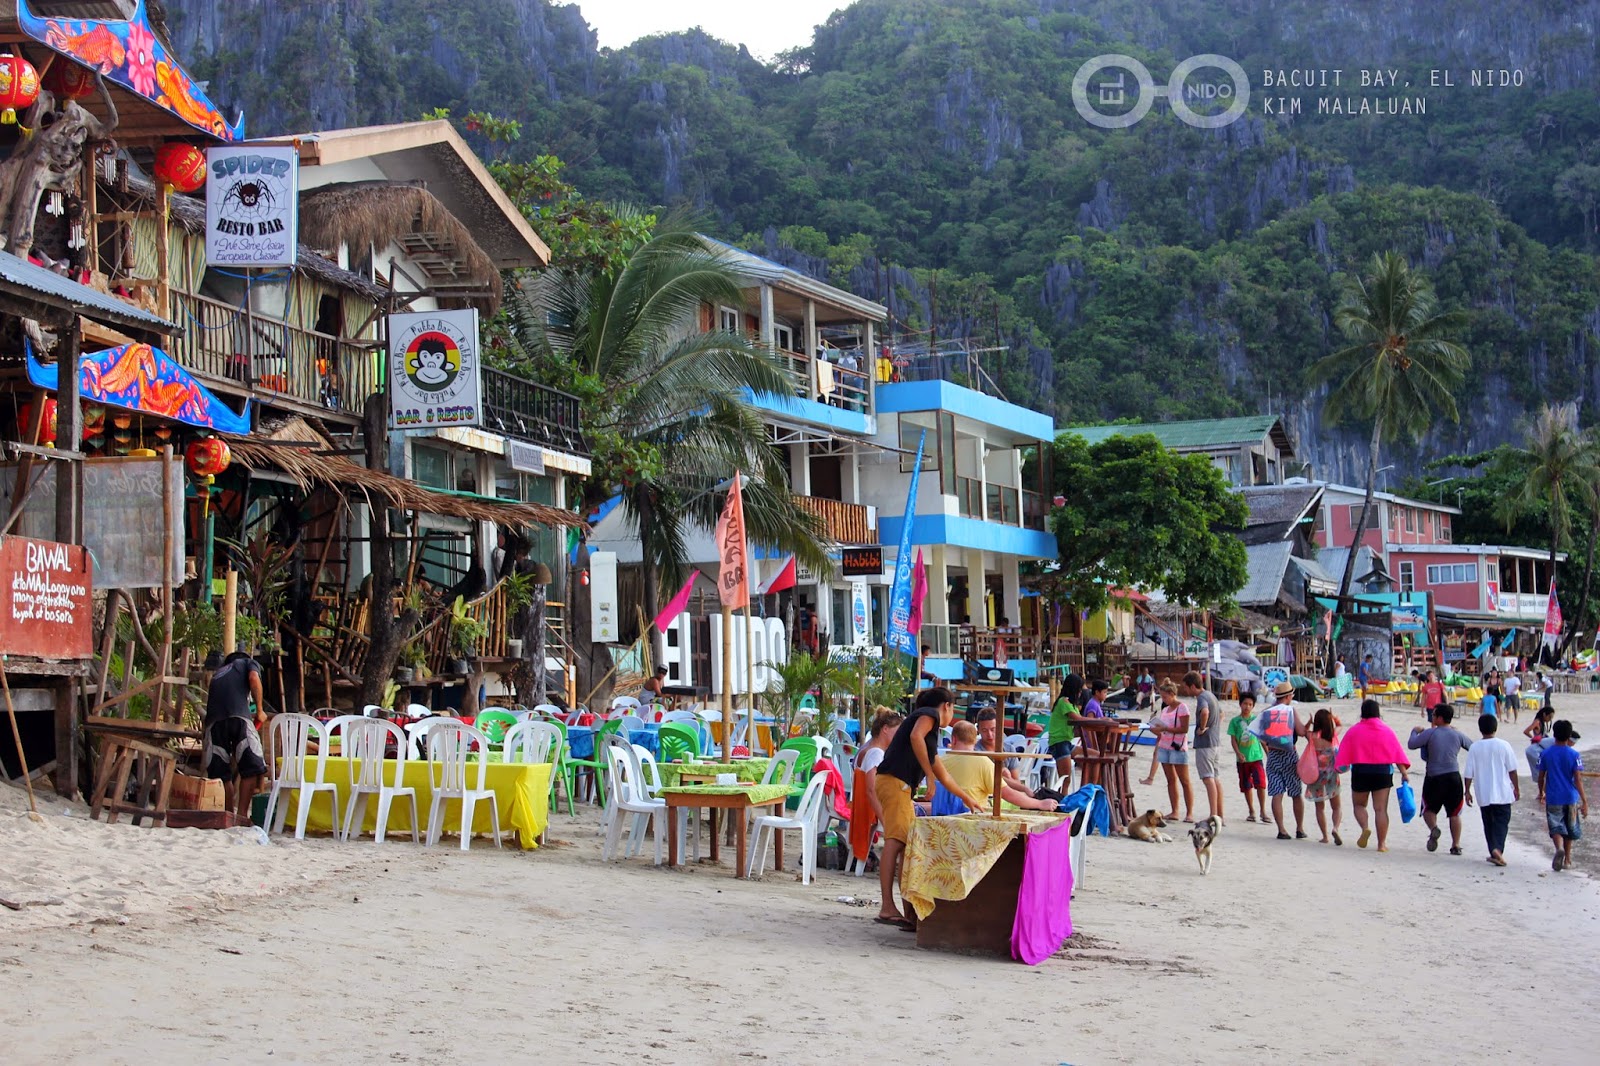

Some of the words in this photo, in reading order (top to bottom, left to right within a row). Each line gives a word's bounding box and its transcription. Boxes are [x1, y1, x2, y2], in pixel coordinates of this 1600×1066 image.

[211, 154, 291, 179] SPIDER
[216, 217, 254, 236] RESTO
[258, 217, 285, 236] BAR
[216, 249, 252, 263] European
[438, 320, 452, 334] Bar
[395, 409, 422, 425] BAR
[436, 405, 475, 423] RESTO
[26, 541, 72, 573] BAWAL
[844, 552, 881, 568] Habibi
